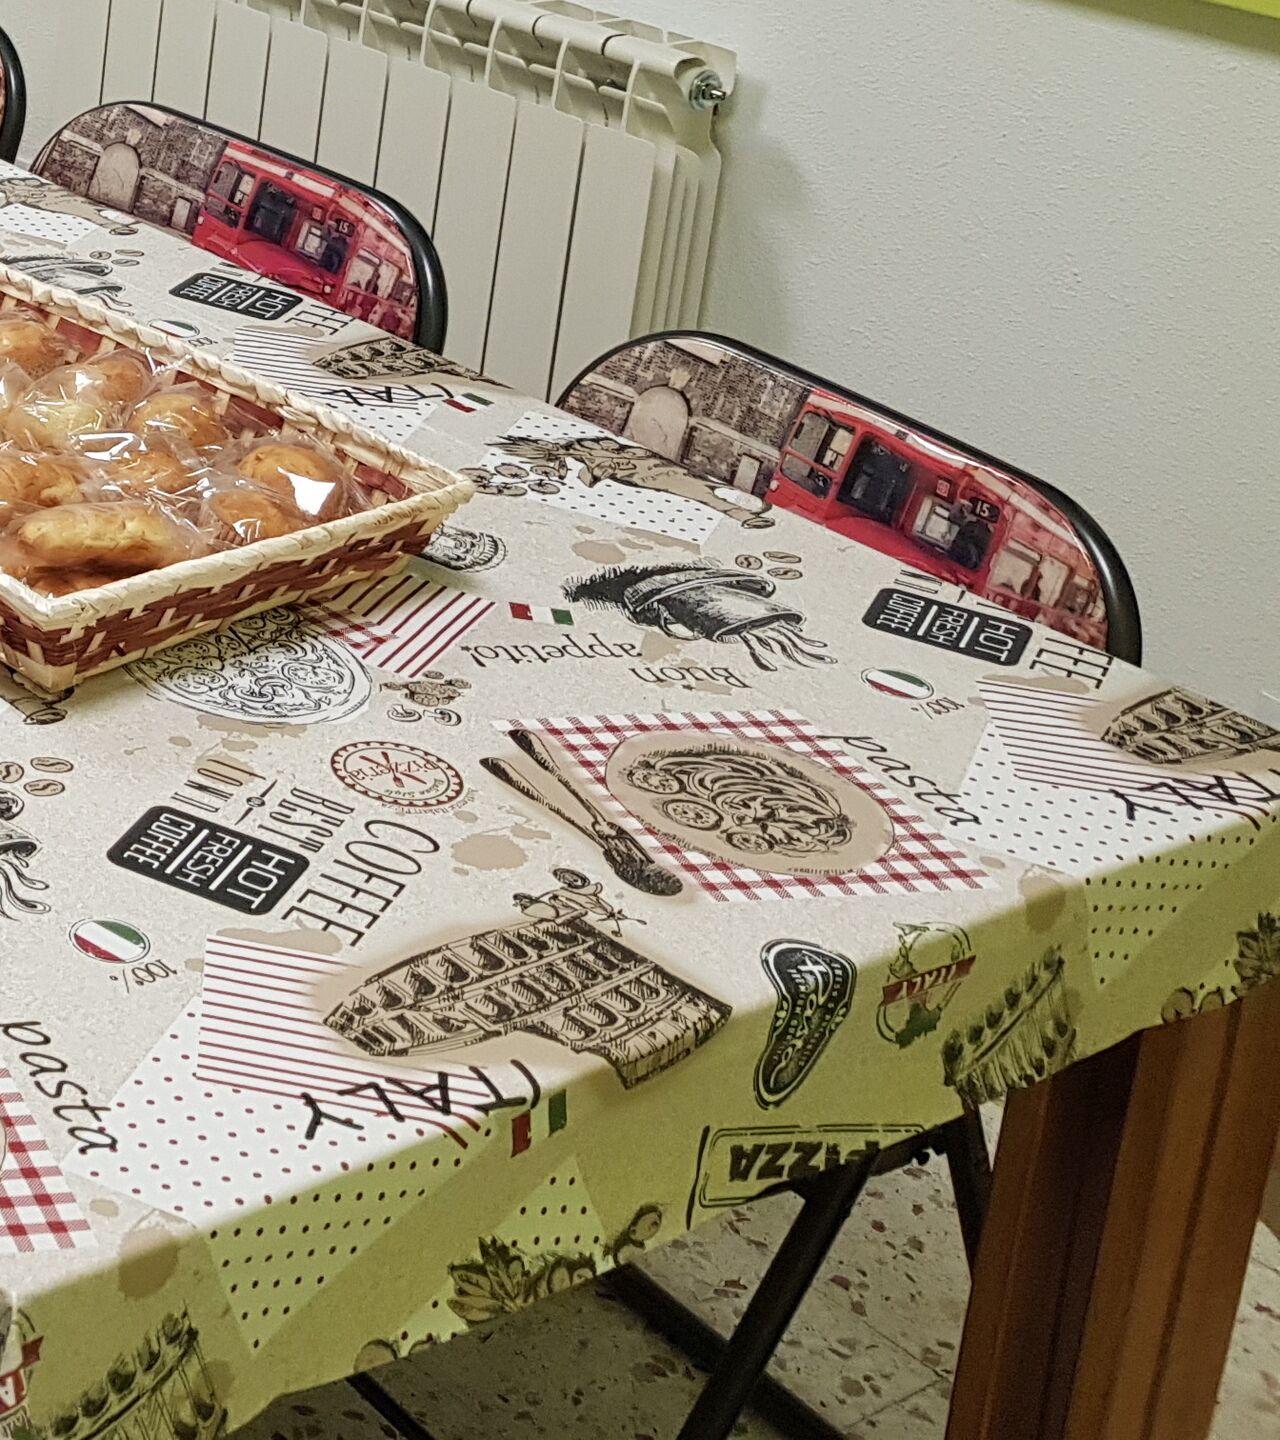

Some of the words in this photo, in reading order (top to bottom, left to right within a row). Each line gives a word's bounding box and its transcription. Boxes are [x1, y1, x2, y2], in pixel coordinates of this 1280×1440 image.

[338, 221, 349, 233] 15
[257, 291, 299, 319] HOT
[975, 501, 990, 517] 15
[875, 595, 925, 633] COFFEE
[927, 605, 968, 648] FRESH
[470, 631, 644, 669] appetito!
[972, 616, 1026, 662] HOT
[634, 665, 752, 689] Buon
[911, 695, 966, 720] 100%
[170, 757, 268, 814] TOWN
[818, 733, 981, 829] pasta
[123, 812, 197, 869] COFFEE
[259, 787, 355, 853] BEST
[183, 831, 242, 886] FRESH
[227, 847, 296, 910] HOT
[281, 818, 441, 948] COFFEE
[109, 963, 178, 995] 100%
[897, 961, 957, 1000] ITALY
[301, 1059, 540, 1140] ITALY
